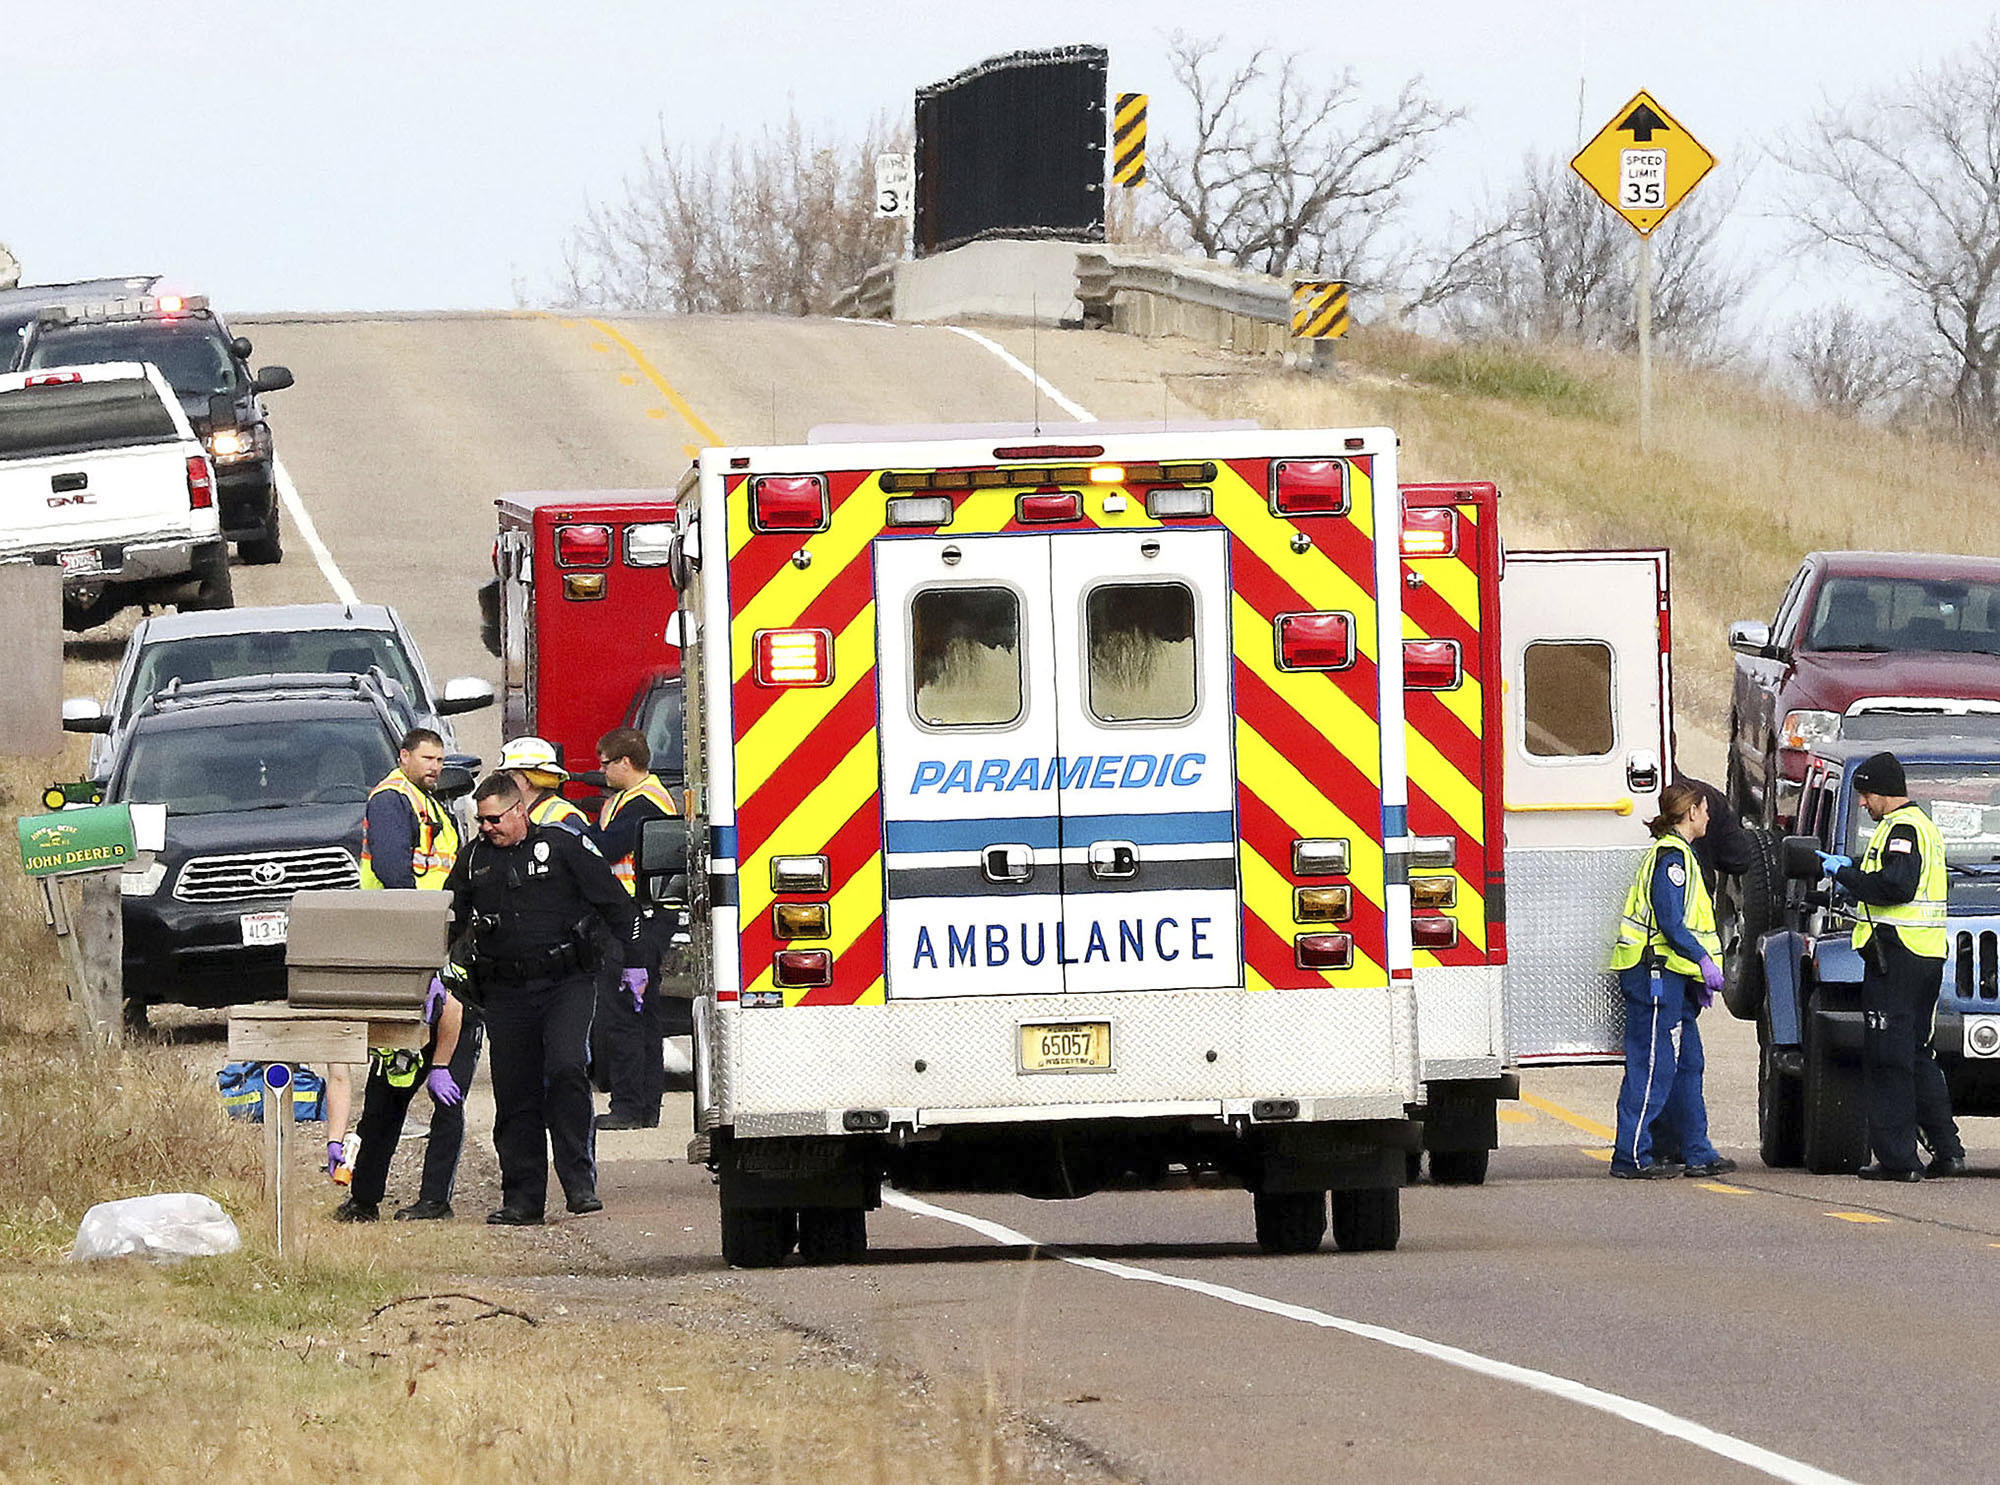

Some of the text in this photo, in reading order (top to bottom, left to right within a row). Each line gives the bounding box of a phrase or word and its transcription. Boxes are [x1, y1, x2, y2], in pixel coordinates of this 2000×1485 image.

[1626, 155, 1663, 166] SPEED
[1628, 169, 1657, 178] LIMIT
[1626, 182, 1660, 204] 35
[46, 494, 98, 508] GMC
[910, 753, 1206, 795] PARAMEDIC
[25, 854, 62, 870] JOHN
[65, 846, 111, 864] DEERE
[913, 917, 1213, 969] AMBULANCE
[1041, 1033, 1091, 1056] 65057
